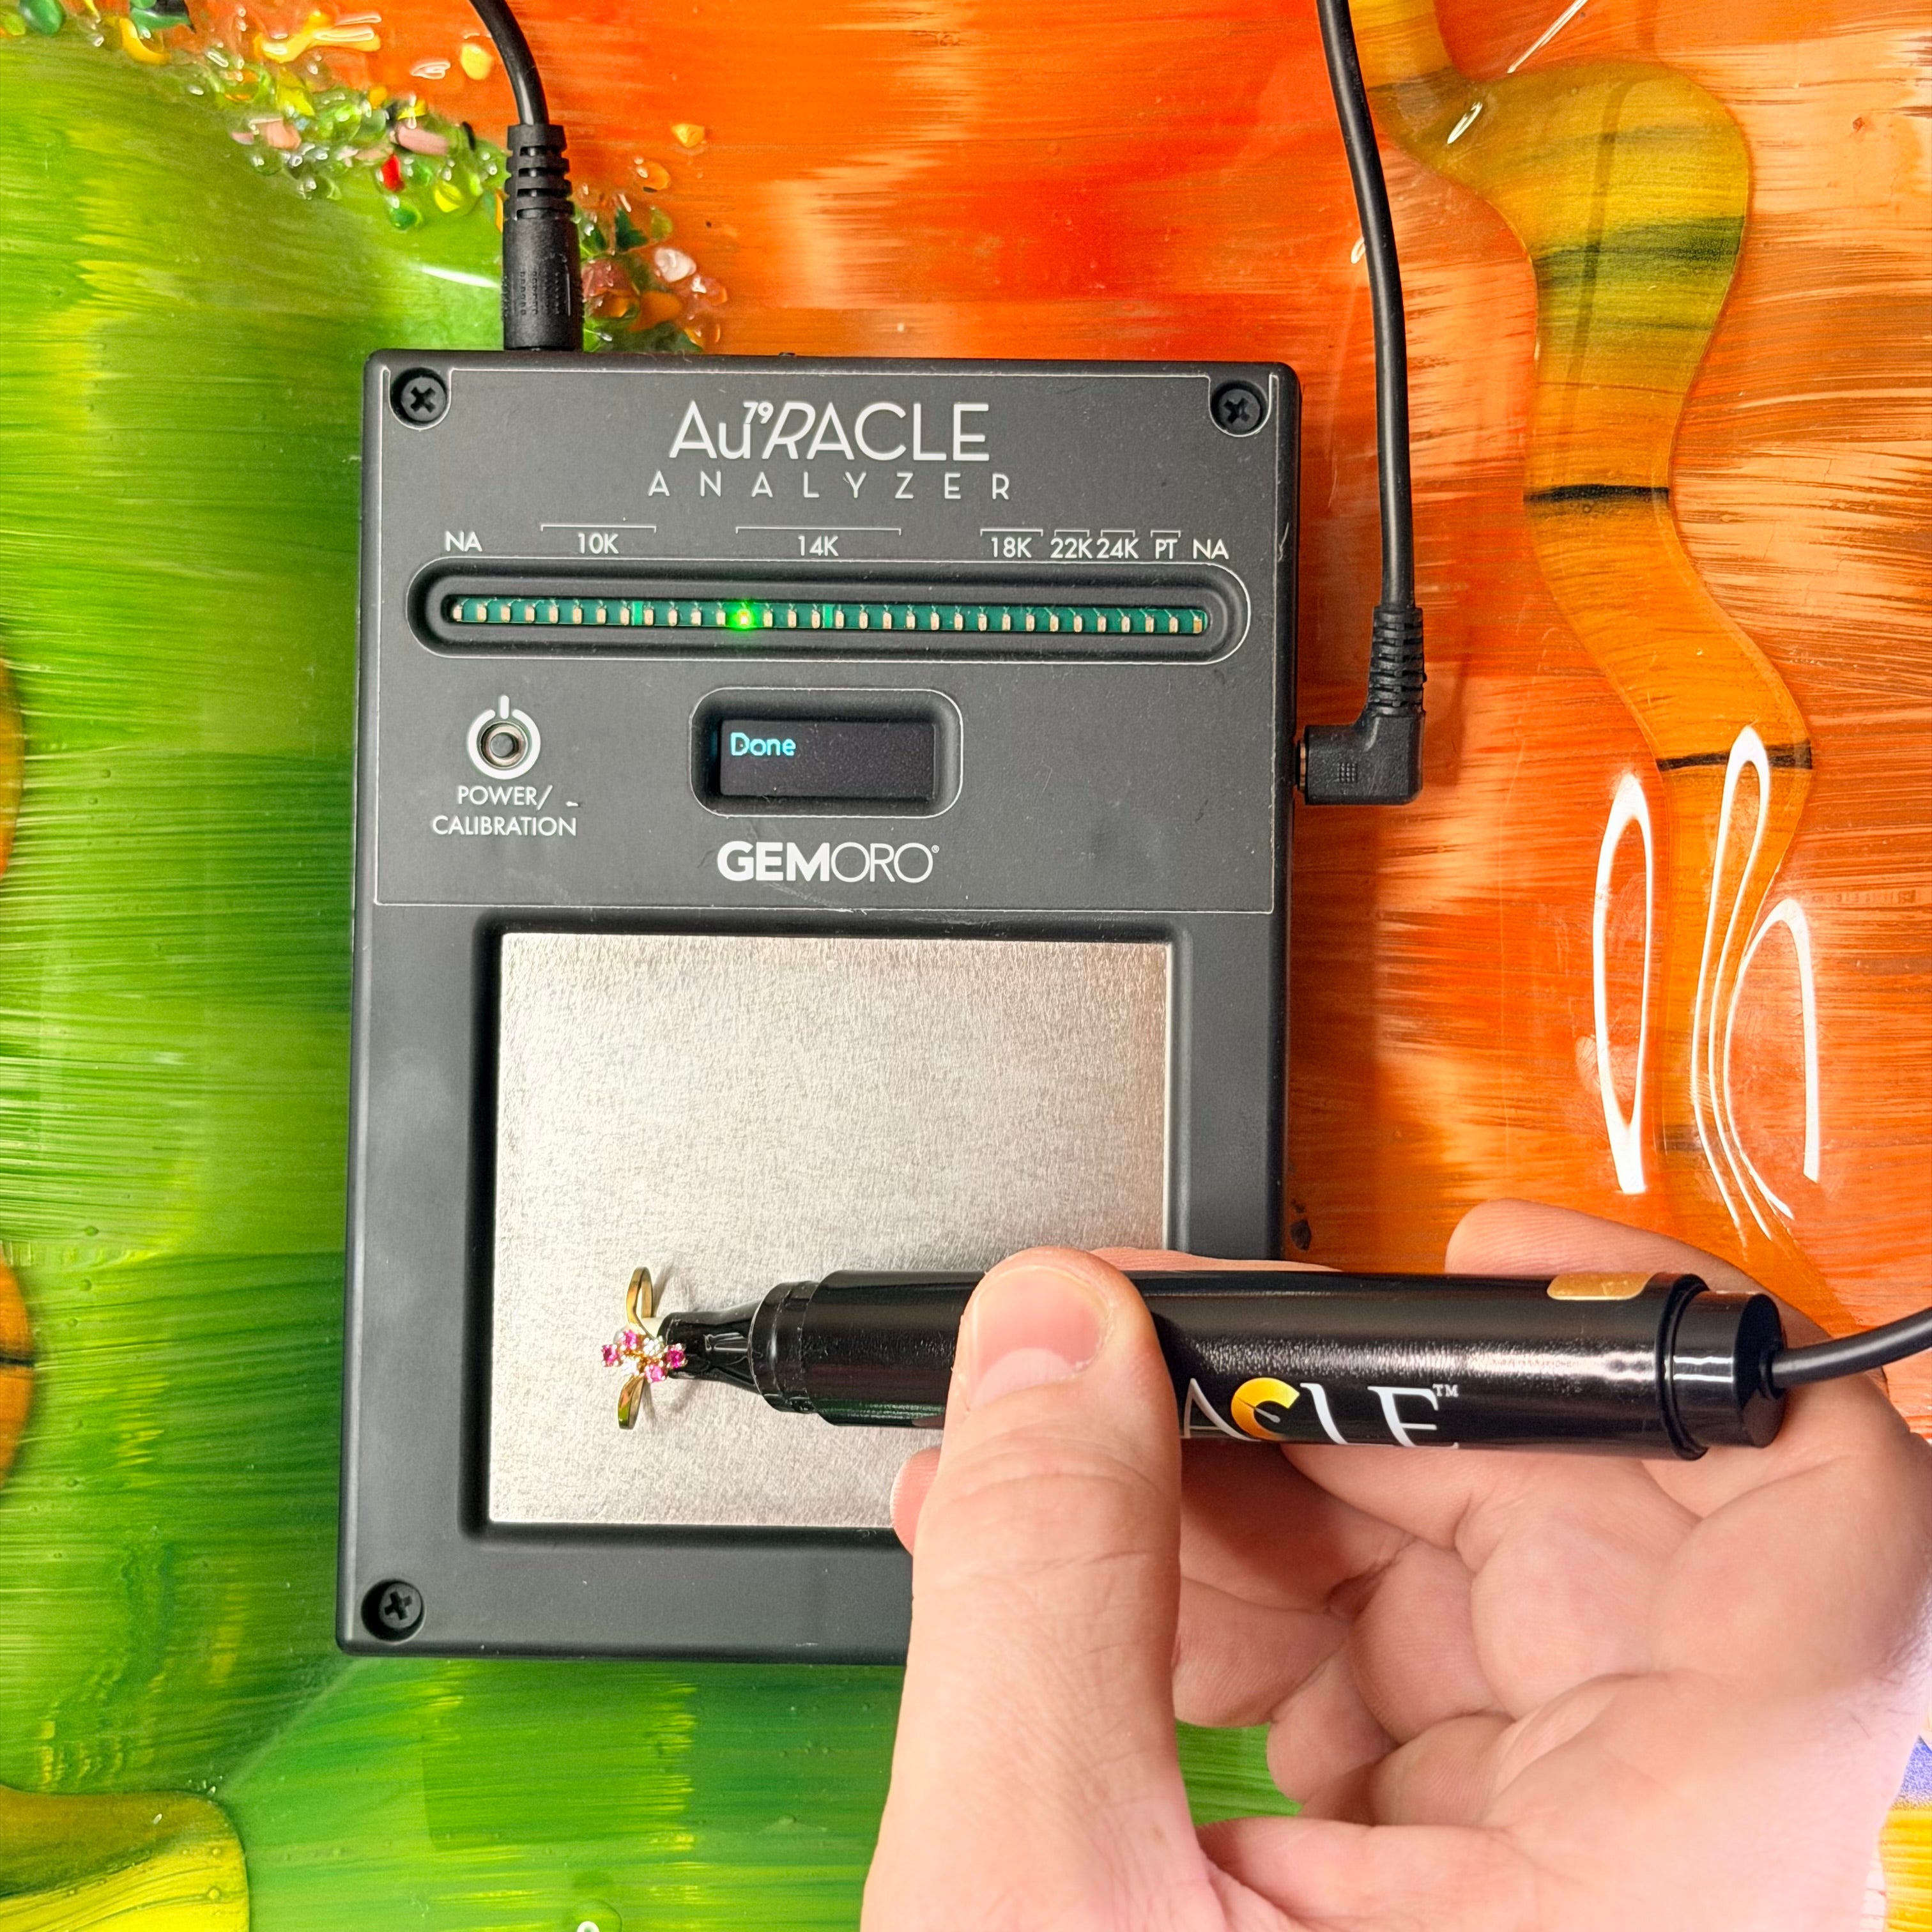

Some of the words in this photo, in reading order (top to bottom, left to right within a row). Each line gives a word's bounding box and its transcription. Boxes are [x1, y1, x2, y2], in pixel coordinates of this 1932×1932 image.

[648, 470, 1010, 500] ANALYZER
[445, 530, 483, 552] NA
[578, 532, 619, 554] 10K
[797, 535, 839, 556] 14K
[990, 537, 1032, 558] 18K
[1050, 537, 1093, 559] 22K
[1096, 537, 1139, 559] 24K
[1155, 538, 1178, 560] PT
[1192, 539, 1229, 560] NA
[730, 732, 797, 757] Done
[457, 785, 553, 811] POWER/
[431, 815, 577, 836] CALIBRATION
